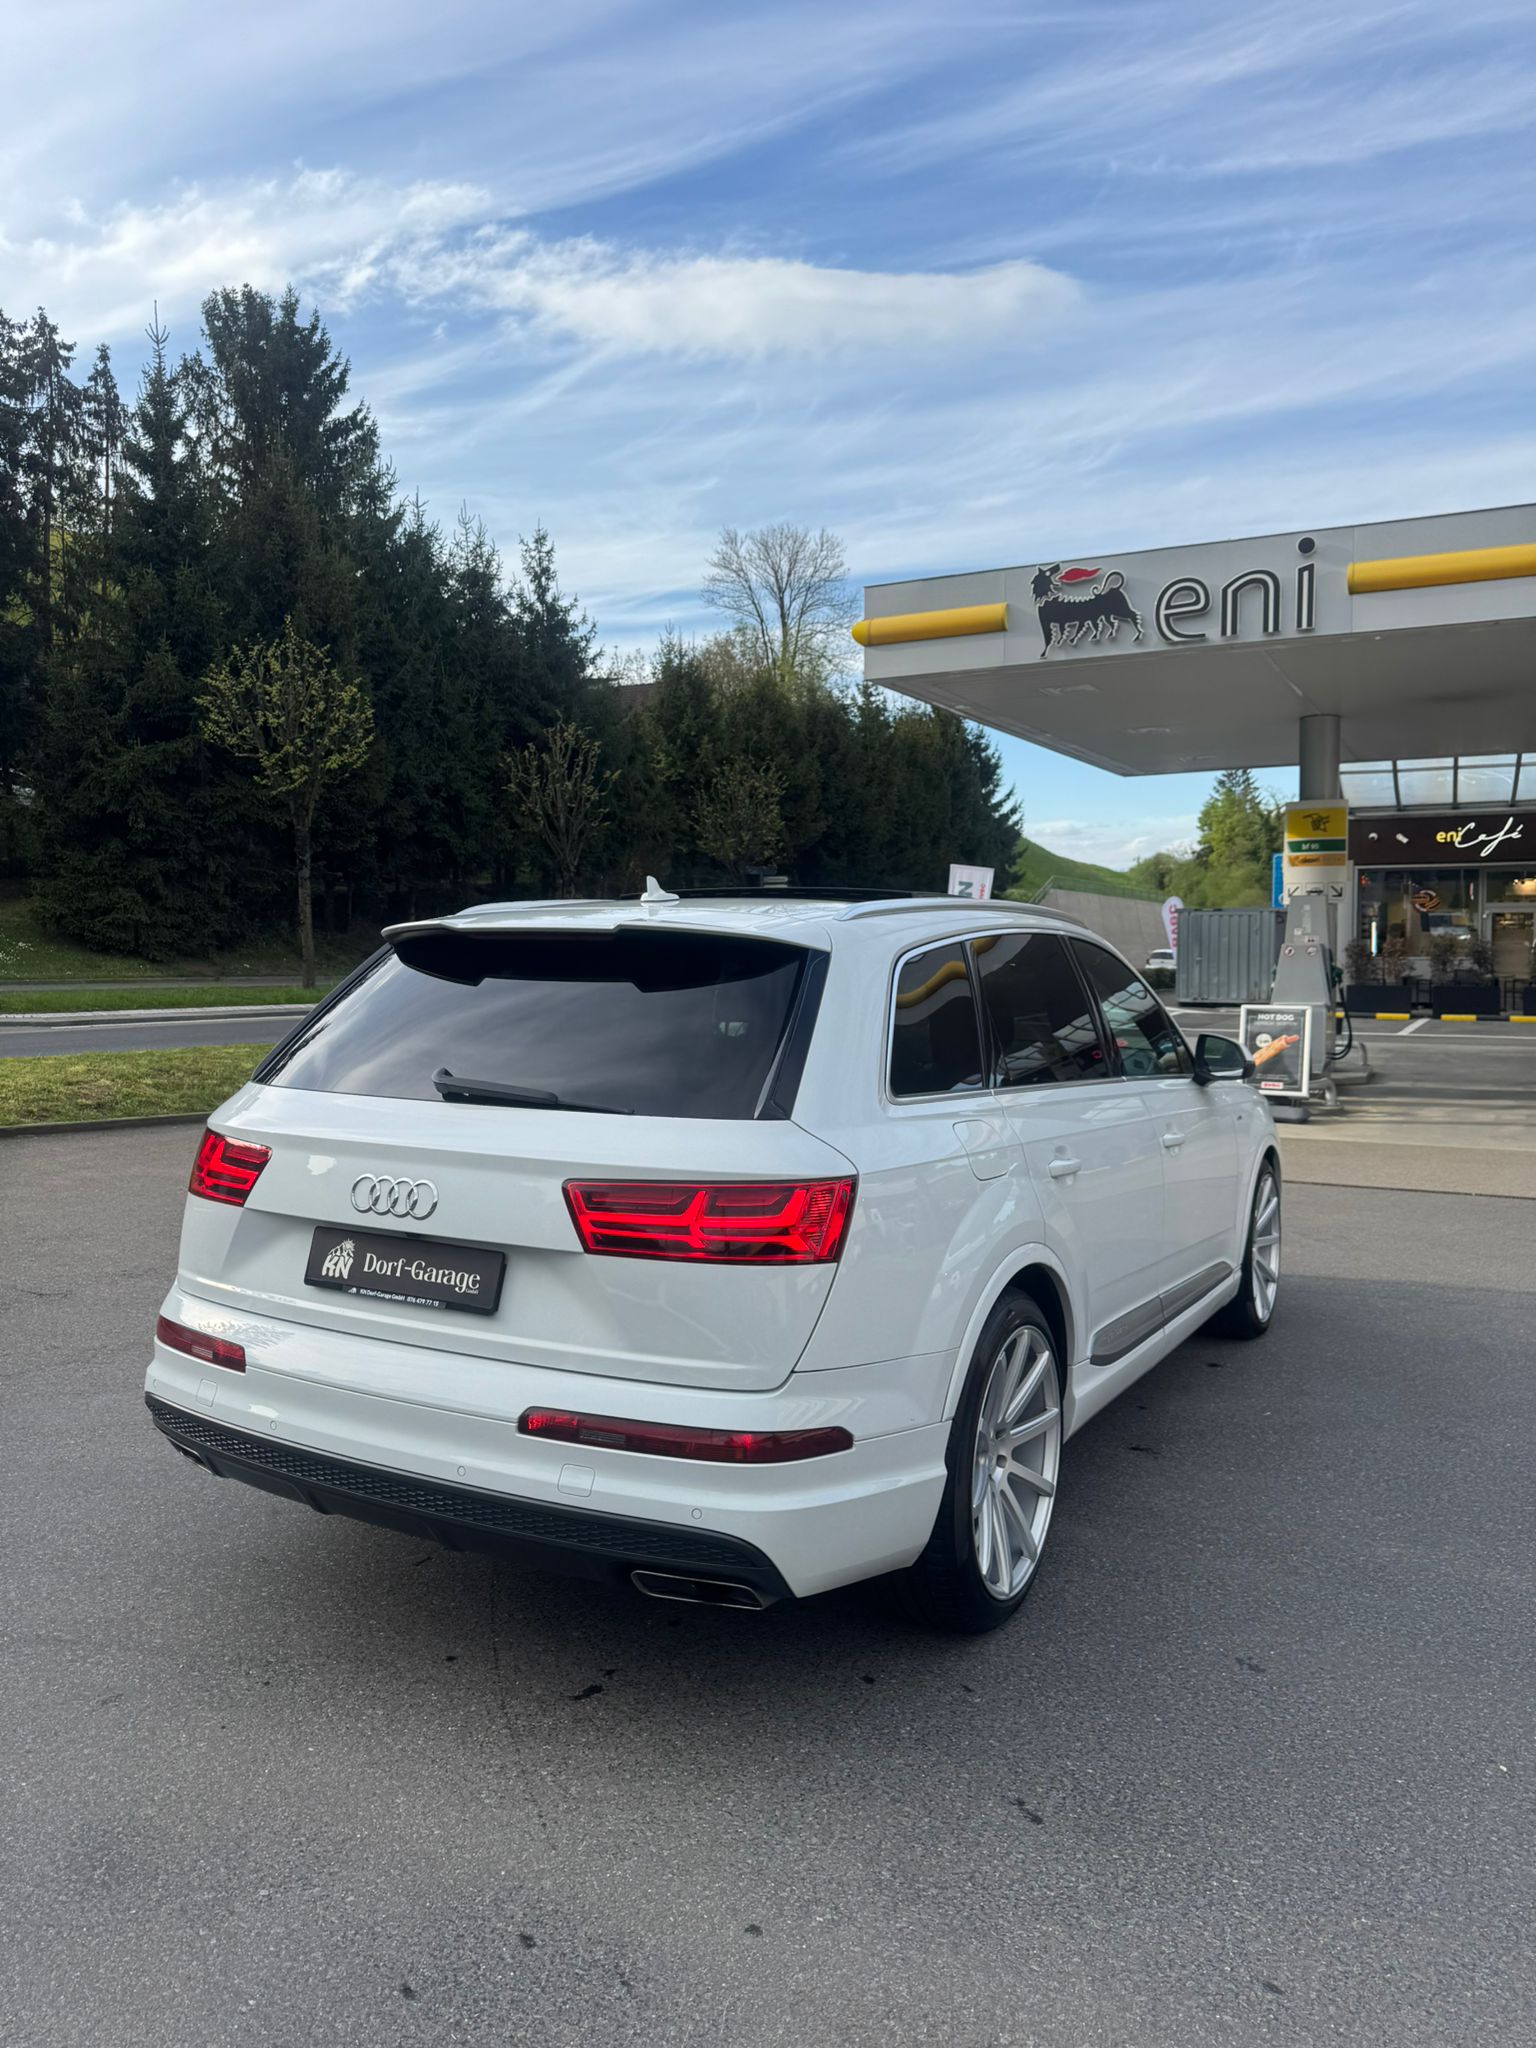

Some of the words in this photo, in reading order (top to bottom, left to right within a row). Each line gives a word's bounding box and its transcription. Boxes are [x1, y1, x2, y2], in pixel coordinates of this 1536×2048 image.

[1154, 536, 1316, 642] eni
[1276, 1013, 1295, 1021] DOG
[321, 1254, 354, 1280] KN
[363, 1252, 481, 1294] Dorf-Garage
